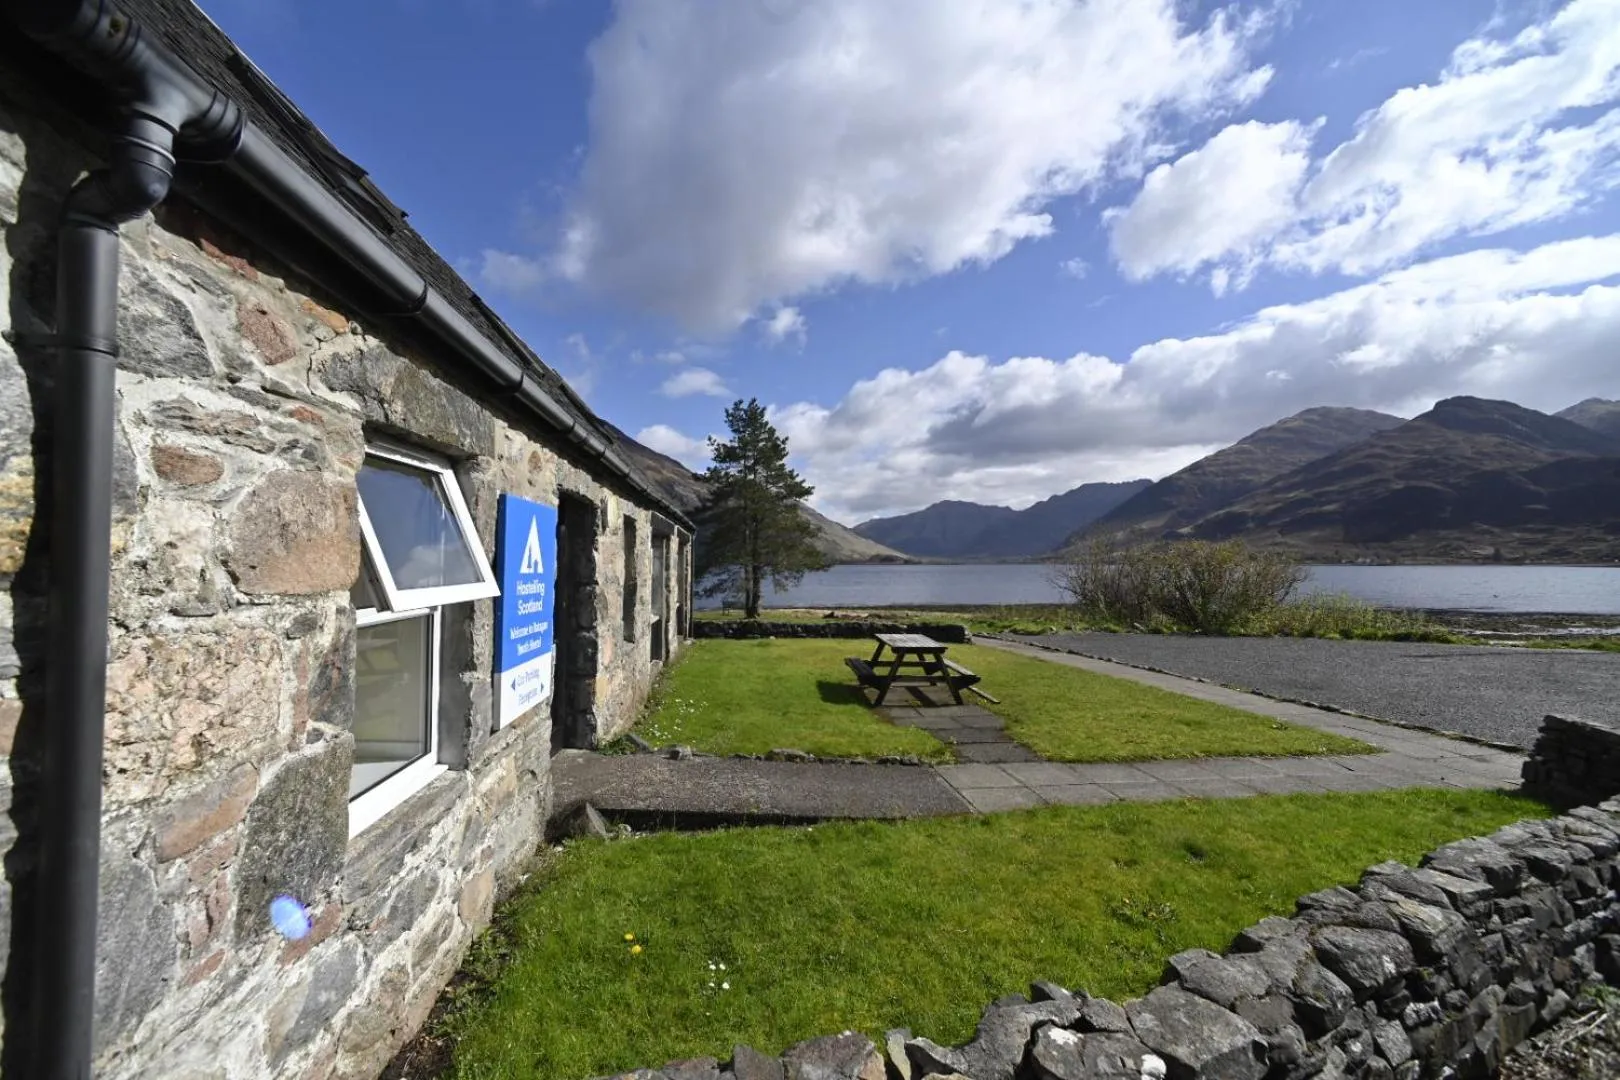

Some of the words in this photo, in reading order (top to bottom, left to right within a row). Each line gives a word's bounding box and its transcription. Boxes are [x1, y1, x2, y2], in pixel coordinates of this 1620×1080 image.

[516, 579, 545, 597] Hostelling
[517, 597, 543, 616] Scotland
[510, 624, 529, 640] Welcome
